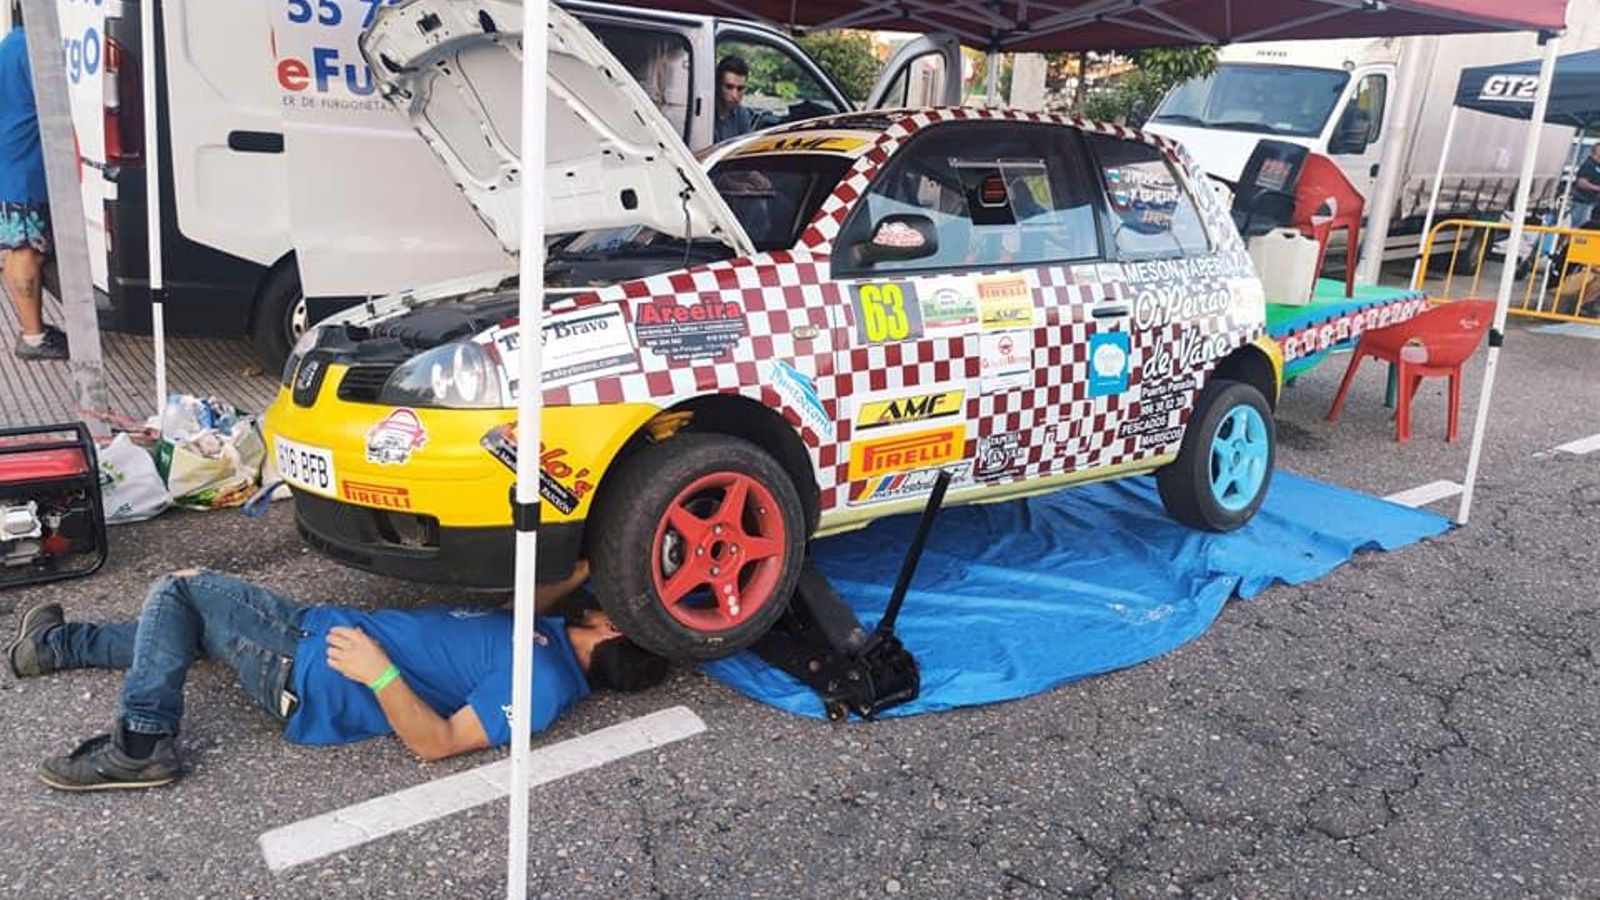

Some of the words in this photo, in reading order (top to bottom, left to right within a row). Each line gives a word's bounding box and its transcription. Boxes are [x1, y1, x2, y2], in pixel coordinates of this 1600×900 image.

[322, 99, 388, 111] FURGONETA
[639, 301, 742, 325] Areeira
[859, 283, 910, 342] 63
[553, 320, 609, 340] Bravo
[879, 394, 947, 424] AMF
[862, 431, 954, 472] PIRELLI
[301, 451, 329, 489] BFB
[342, 480, 412, 508] PIRELLI
